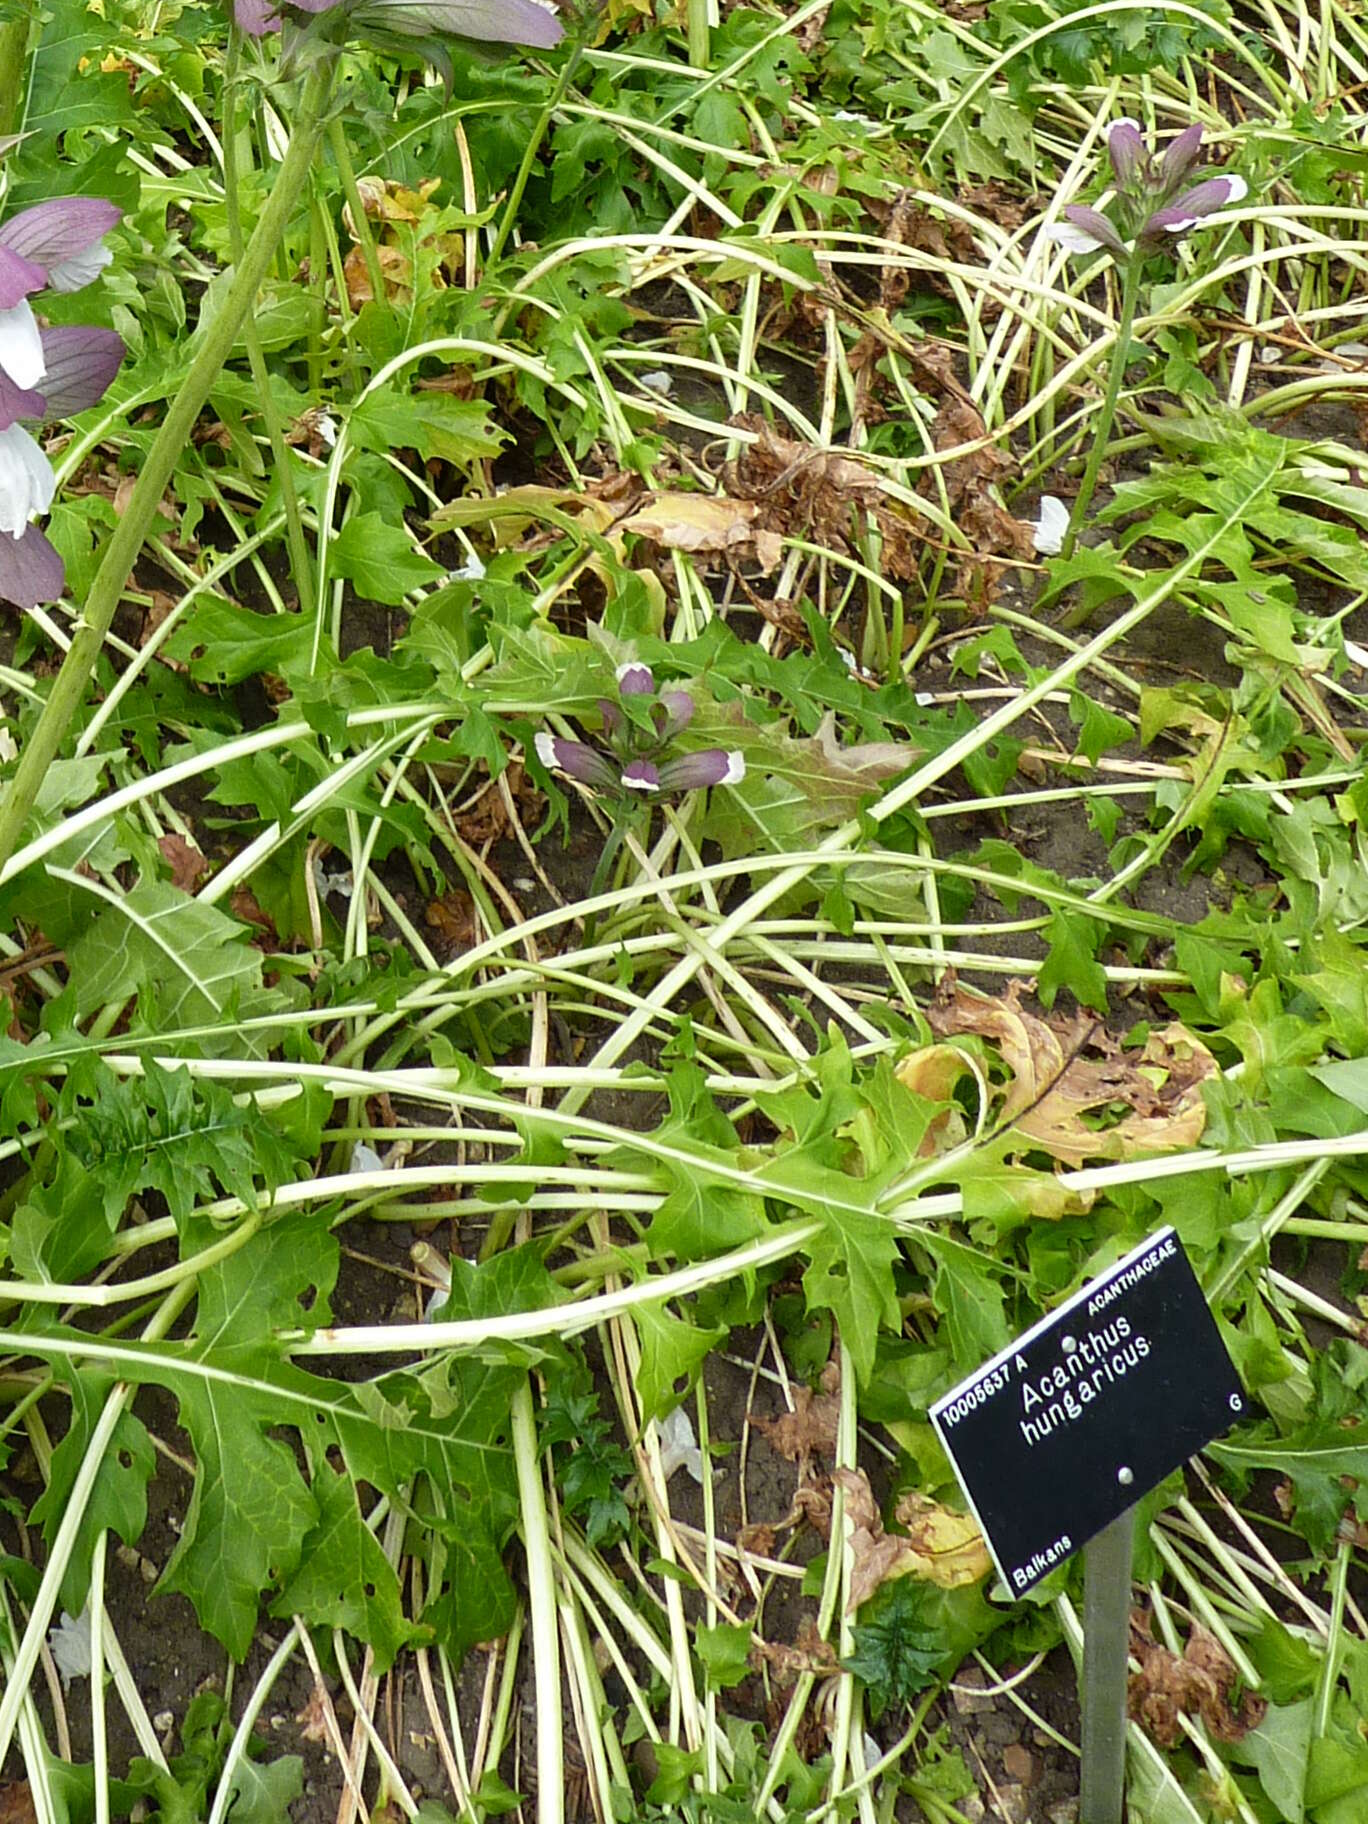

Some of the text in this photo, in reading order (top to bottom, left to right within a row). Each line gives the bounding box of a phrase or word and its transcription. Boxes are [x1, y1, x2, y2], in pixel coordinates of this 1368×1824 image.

[1088, 1239, 1177, 1317] ACANTHACEAE
[942, 1354, 1029, 1427] 10005637 A
[1019, 1336, 1150, 1446] hungaricus
[1021, 1316, 1131, 1414] Acanthus
[1229, 1393, 1243, 1412] G
[1012, 1535, 1072, 1588] Balkans
